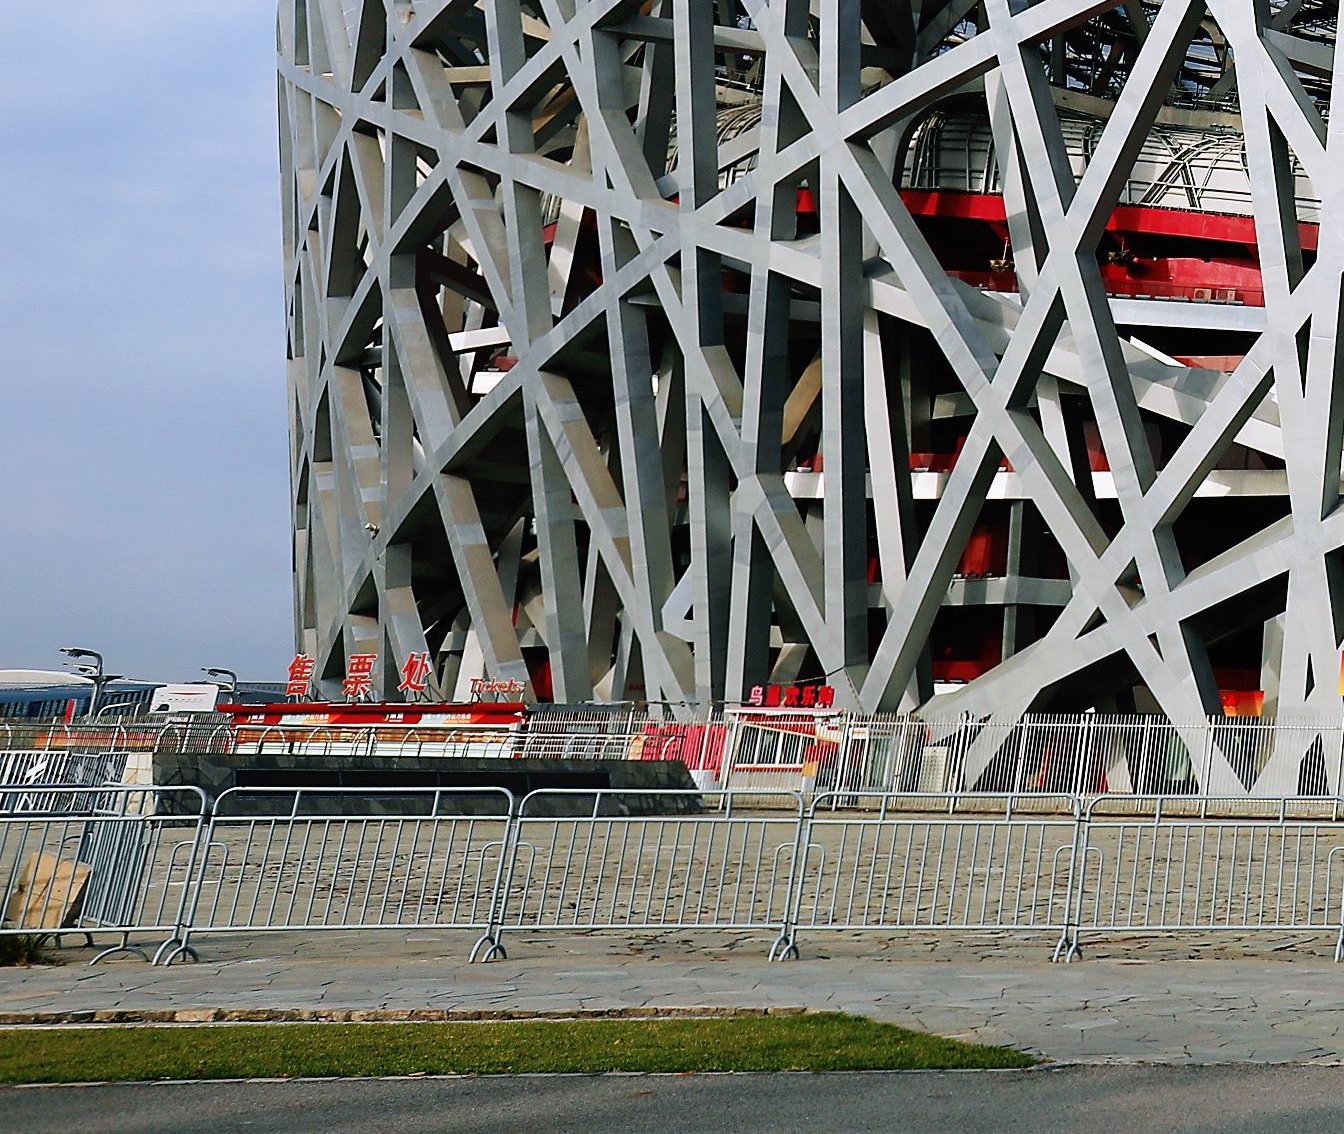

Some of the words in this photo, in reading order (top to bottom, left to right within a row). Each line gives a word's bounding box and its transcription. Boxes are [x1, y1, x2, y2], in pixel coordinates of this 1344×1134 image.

[285, 651, 432, 697] 售票处
[469, 677, 526, 694] Tickets
